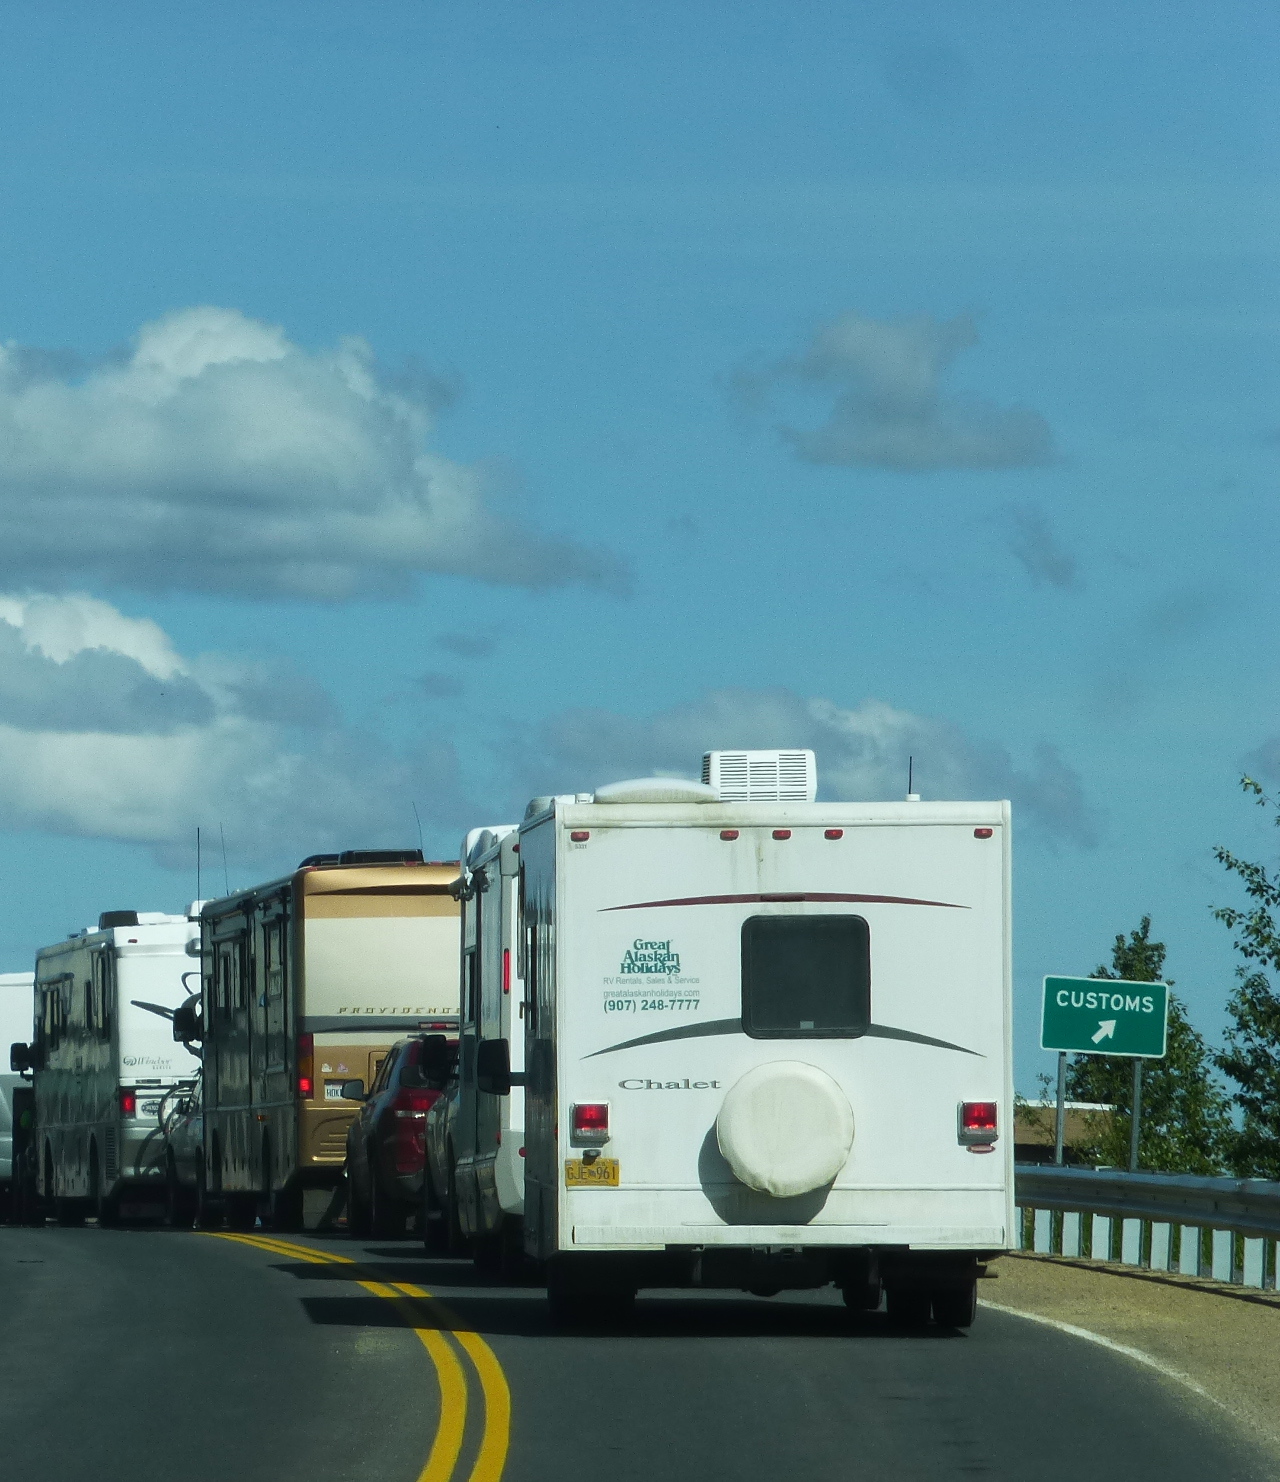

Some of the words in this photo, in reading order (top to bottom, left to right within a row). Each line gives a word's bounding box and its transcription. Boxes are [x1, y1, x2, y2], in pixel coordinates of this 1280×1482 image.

[633, 938, 671, 956] Great
[623, 950, 680, 965] Alaskan
[620, 961, 681, 976] Holidays
[603, 977, 614, 985] RV
[646, 976, 666, 985] Sales
[667, 976, 673, 985] &
[674, 976, 700, 984] Service
[603, 989, 700, 999] greatalaskanholidays.com
[603, 1000, 637, 1014] (907)
[640, 1000, 700, 1011] 248-7777
[1056, 990, 1154, 1013] CUSTOMS
[618, 1078, 722, 1090] Chalet
[567, 1166, 588, 1180] GJE
[596, 1166, 615, 1180] 961
